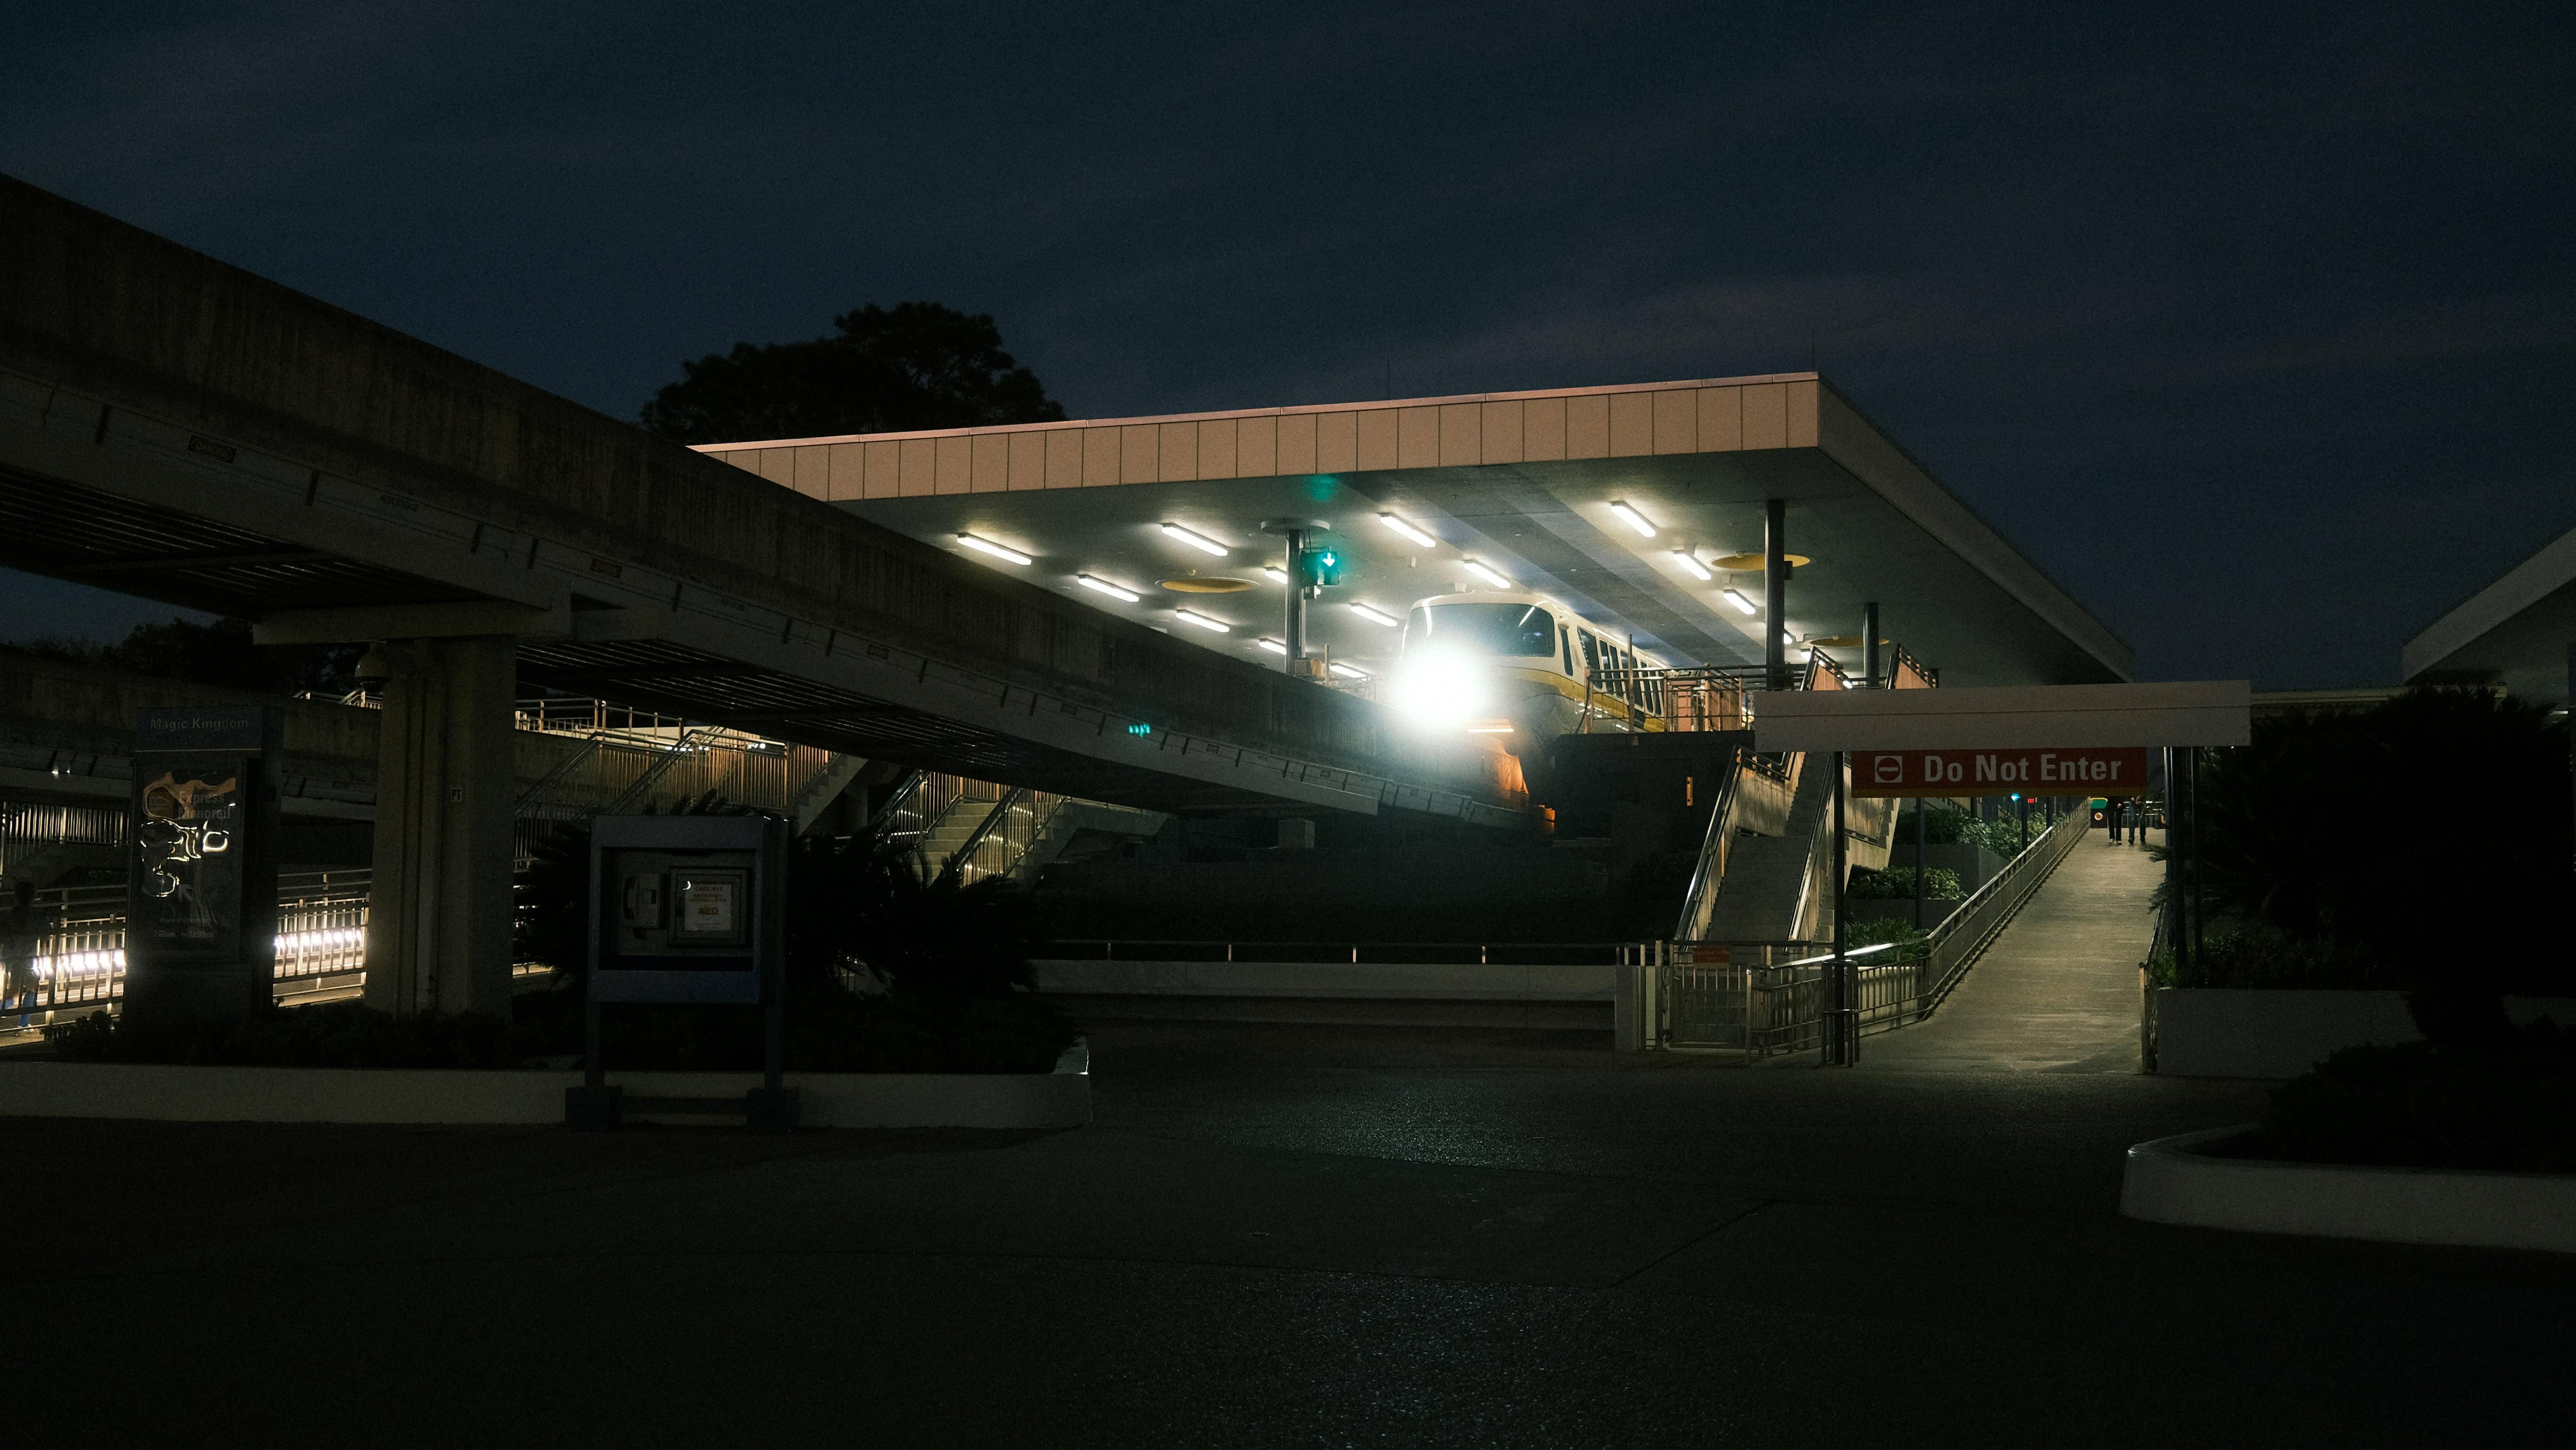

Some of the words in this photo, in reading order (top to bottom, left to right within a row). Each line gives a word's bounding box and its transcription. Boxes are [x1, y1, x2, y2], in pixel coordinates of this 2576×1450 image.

[195, 441, 230, 458] DANGER
[150, 718, 187, 732] Magic
[192, 717, 249, 731] Kingdom
[1925, 755, 1963, 782] Do
[1976, 754, 2029, 781] Not
[2041, 753, 2121, 780] Enter
[179, 790, 225, 806] Express
[452, 789, 461, 800] PT
